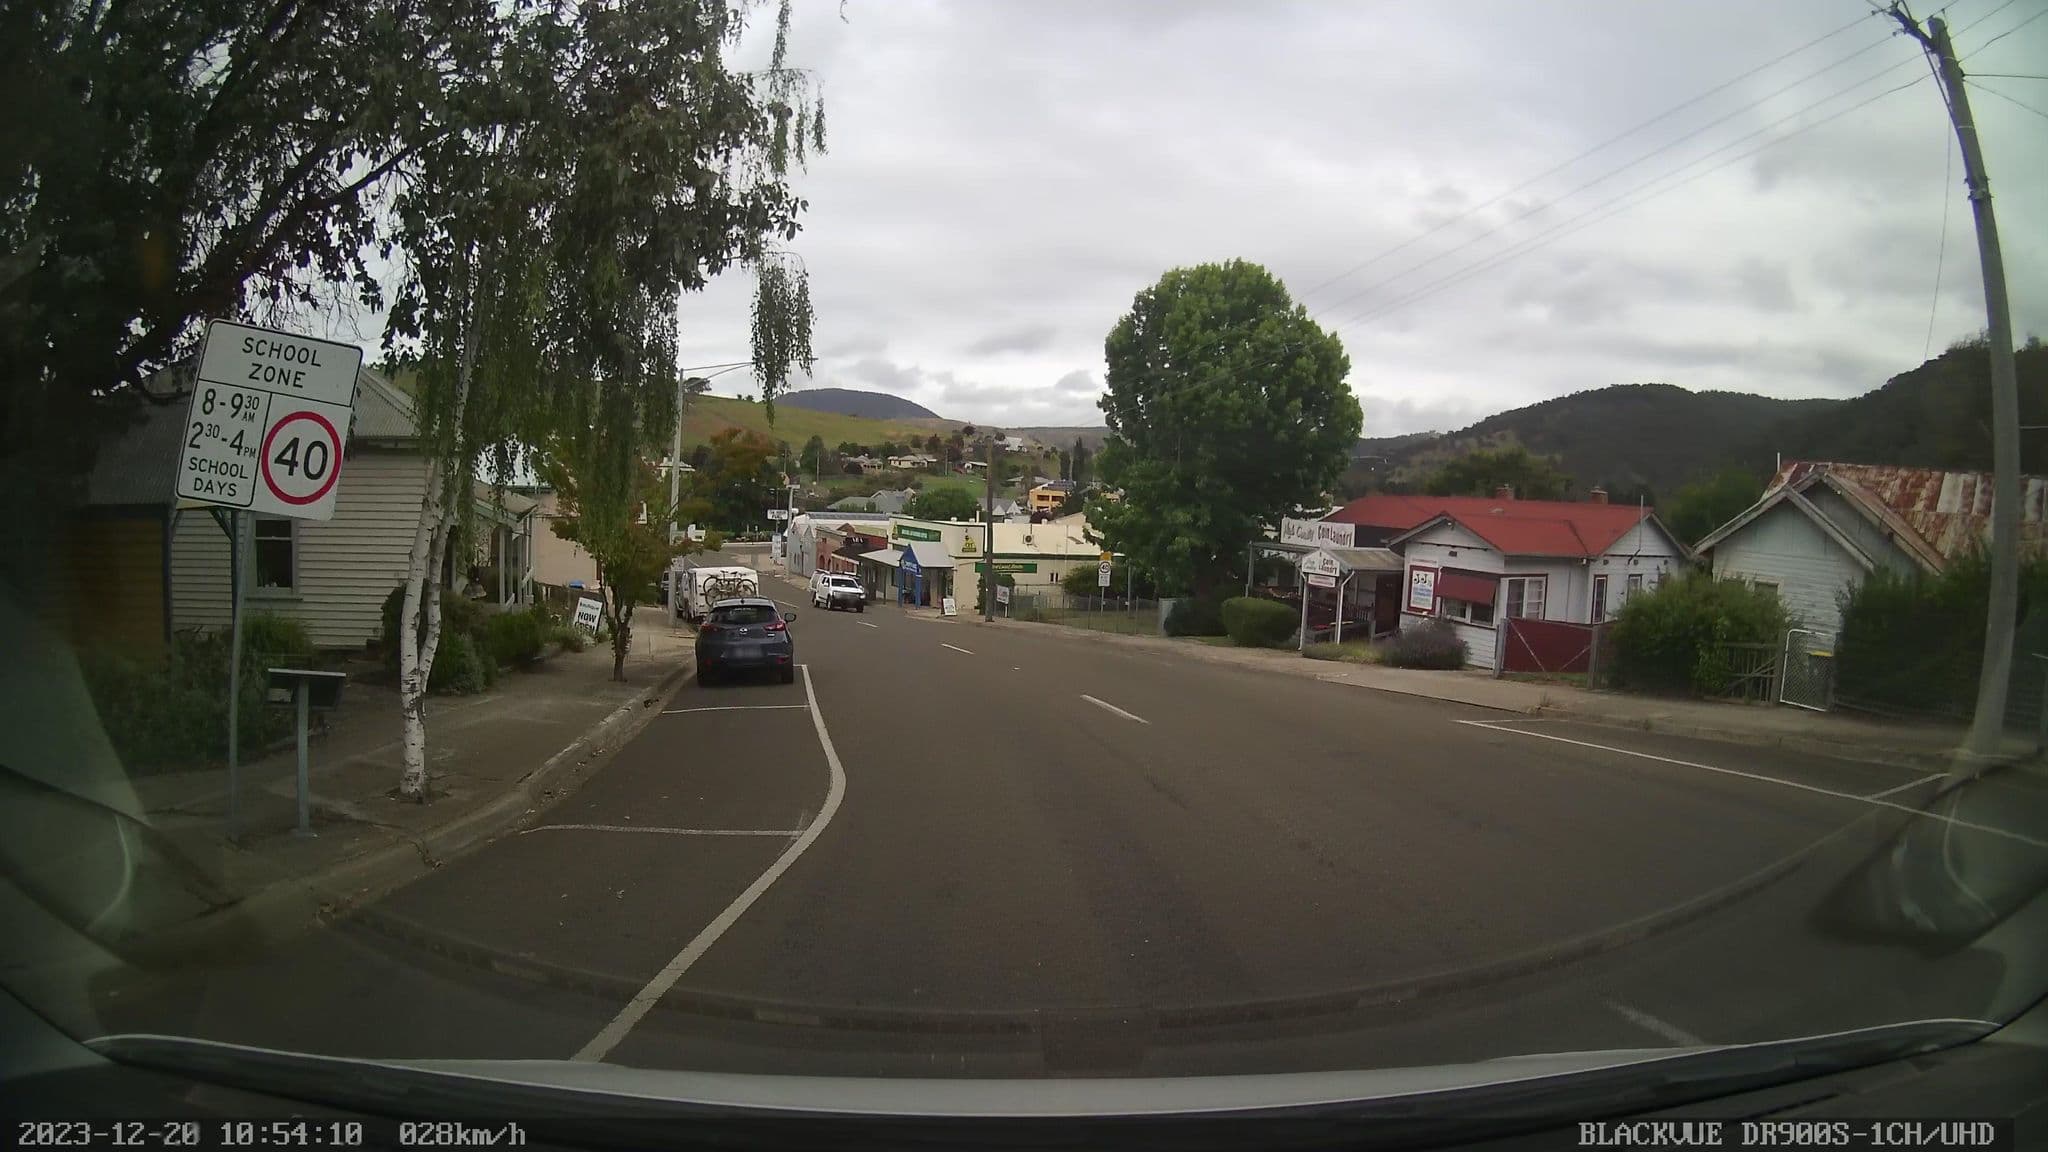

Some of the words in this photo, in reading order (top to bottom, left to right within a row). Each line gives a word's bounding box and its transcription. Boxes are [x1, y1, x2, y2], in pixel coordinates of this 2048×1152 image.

[242, 337, 322, 367] SCHOOL
[248, 363, 306, 388] ZONE
[188, 456, 249, 480] SCHOOL
[274, 437, 329, 481] 40
[193, 477, 237, 497] DAYS
[1330, 525, 1353, 548] Laundry
[578, 611, 597, 623] NOW
